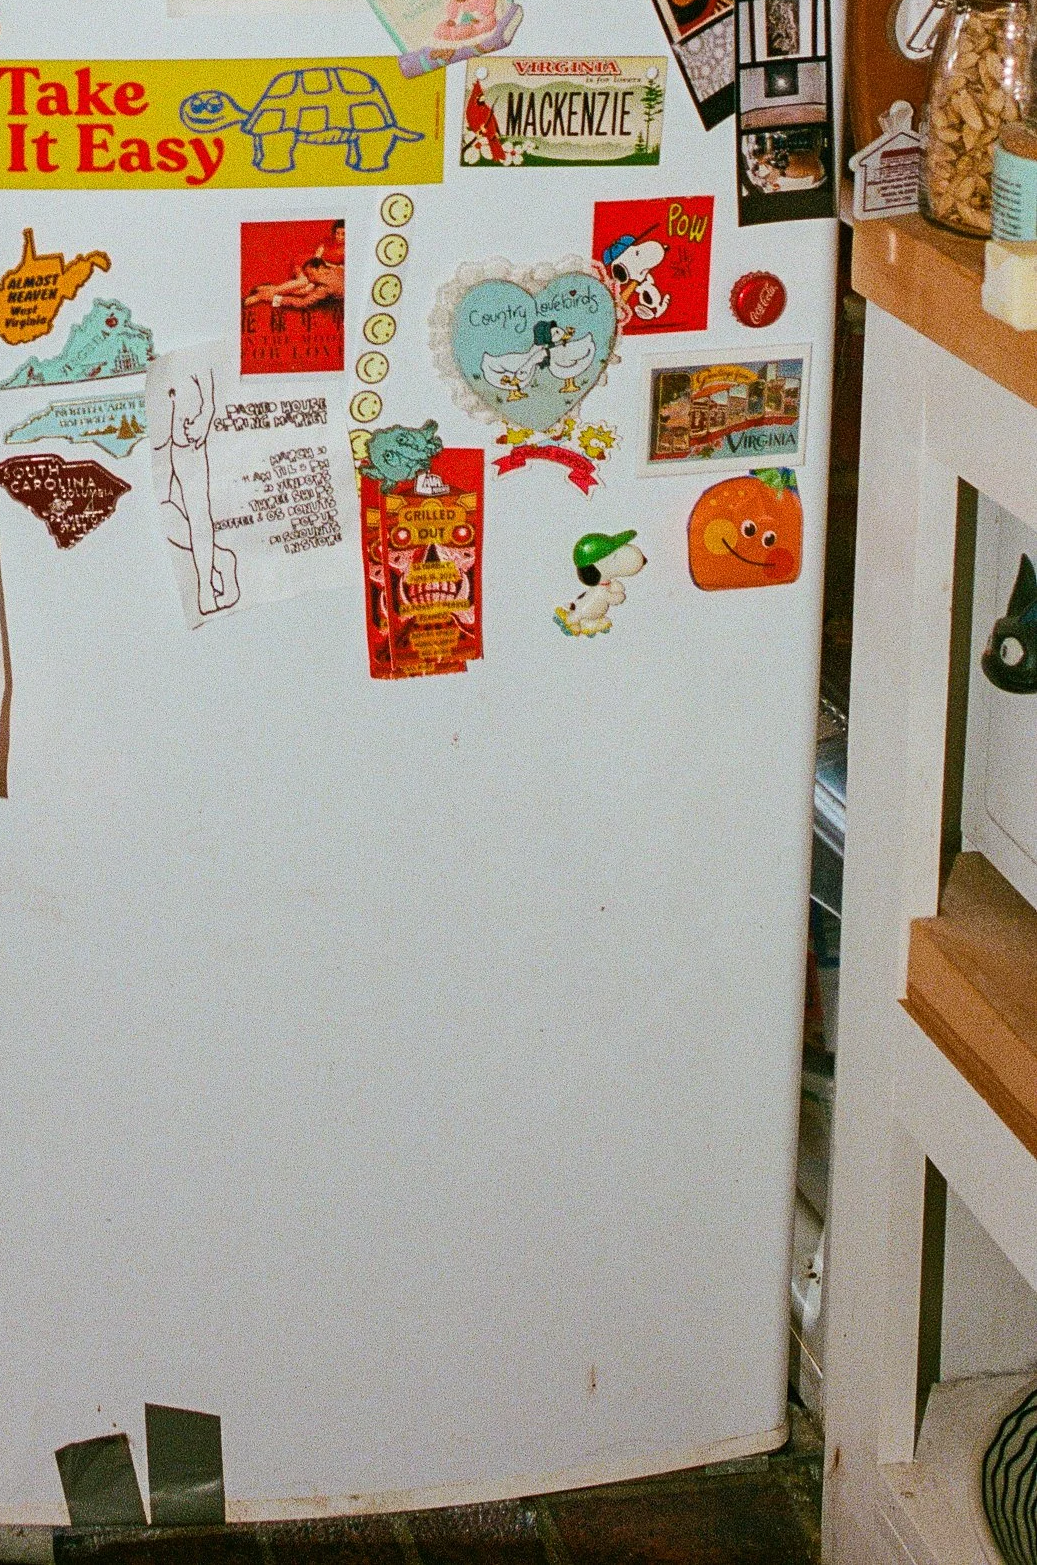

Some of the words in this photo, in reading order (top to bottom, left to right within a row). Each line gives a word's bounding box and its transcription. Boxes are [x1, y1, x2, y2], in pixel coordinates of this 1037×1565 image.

[513, 59, 622, 76] VIRGINIA
[506, 91, 634, 137] MACKENZIE
[7, 124, 59, 173] It
[76, 124, 225, 186] Easy
[7, 273, 59, 290] ALMOST
[7, 288, 58, 303] HEAVEN
[11, 305, 38, 315] West
[5, 315, 47, 330] Virginia
[469, 304, 527, 333] Country
[280, 398, 326, 413] HOUSE
[725, 431, 797, 453] VIRGINIA
[3, 464, 60, 480] SOUTH
[10, 477, 96, 494] CAROLINA
[405, 509, 456, 521] GRILLED
[418, 528, 446, 539] OUT
